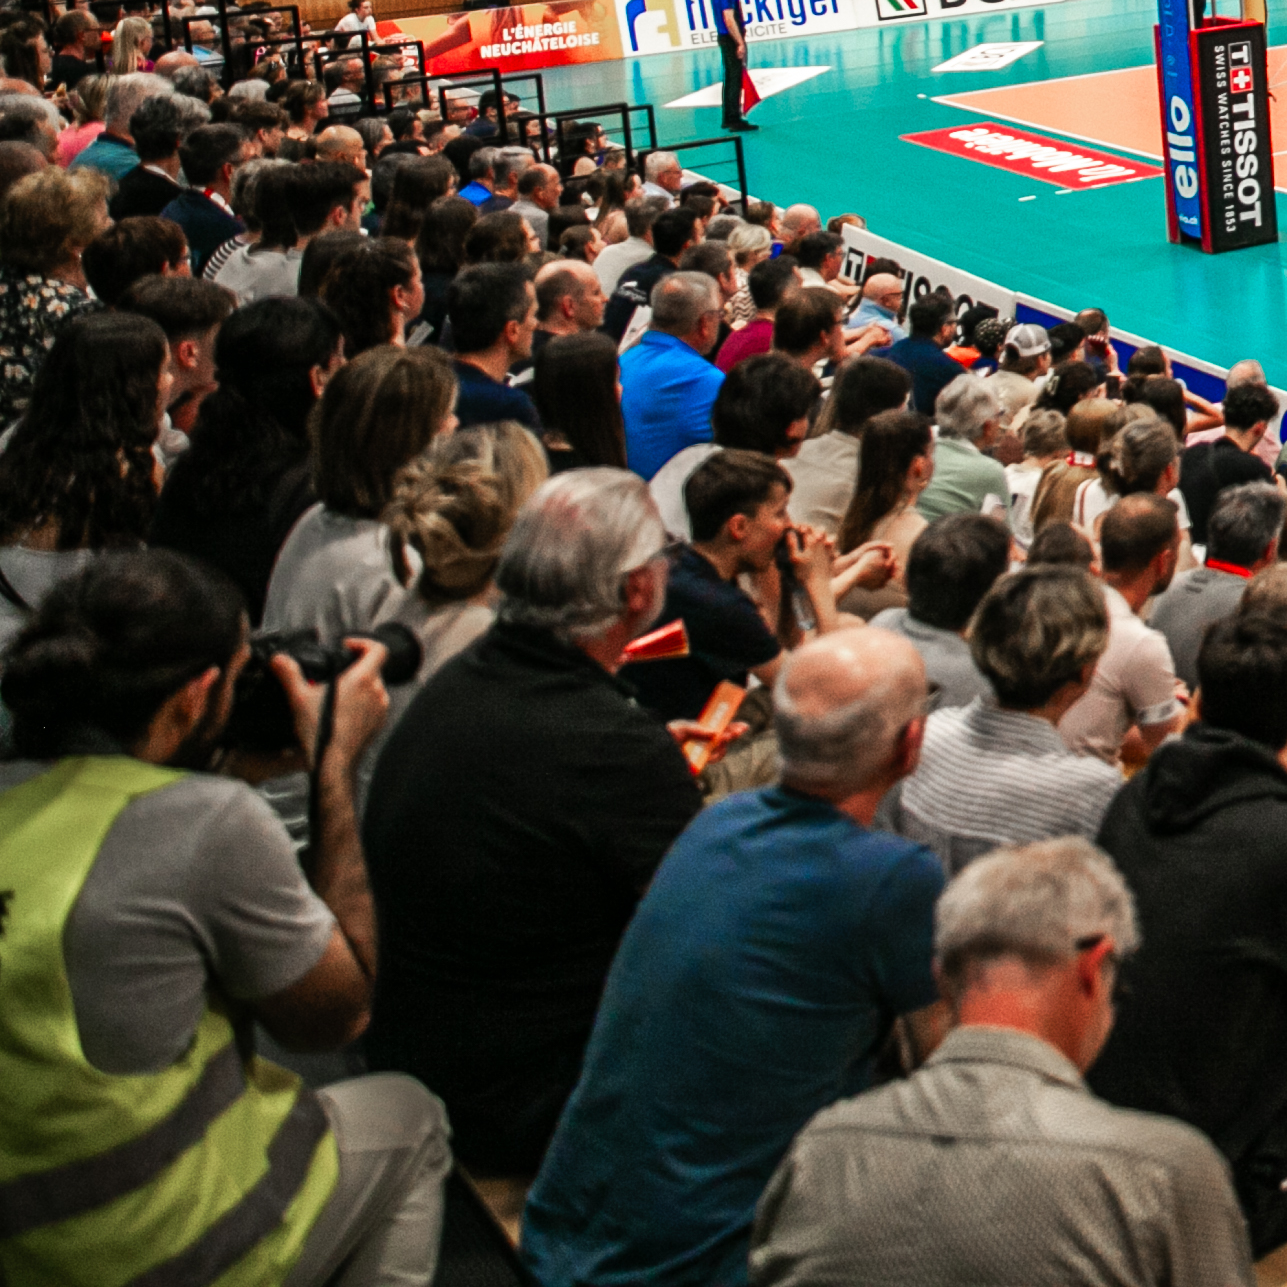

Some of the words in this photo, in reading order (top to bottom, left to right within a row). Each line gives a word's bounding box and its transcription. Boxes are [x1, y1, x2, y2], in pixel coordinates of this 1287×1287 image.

[480, 32, 600, 59] NEUCHÂTELOISE
[503, 21, 577, 42] L'ÉNERGIE
[691, 23, 788, 45] ELEICITE
[1214, 45, 1227, 88] SWISS
[1218, 92, 1231, 155] WATCHES
[1167, 95, 1199, 199] ello
[1232, 92, 1262, 227] TISSOT
[1221, 160, 1234, 199] SINCE
[1225, 204, 1237, 233] 1853
